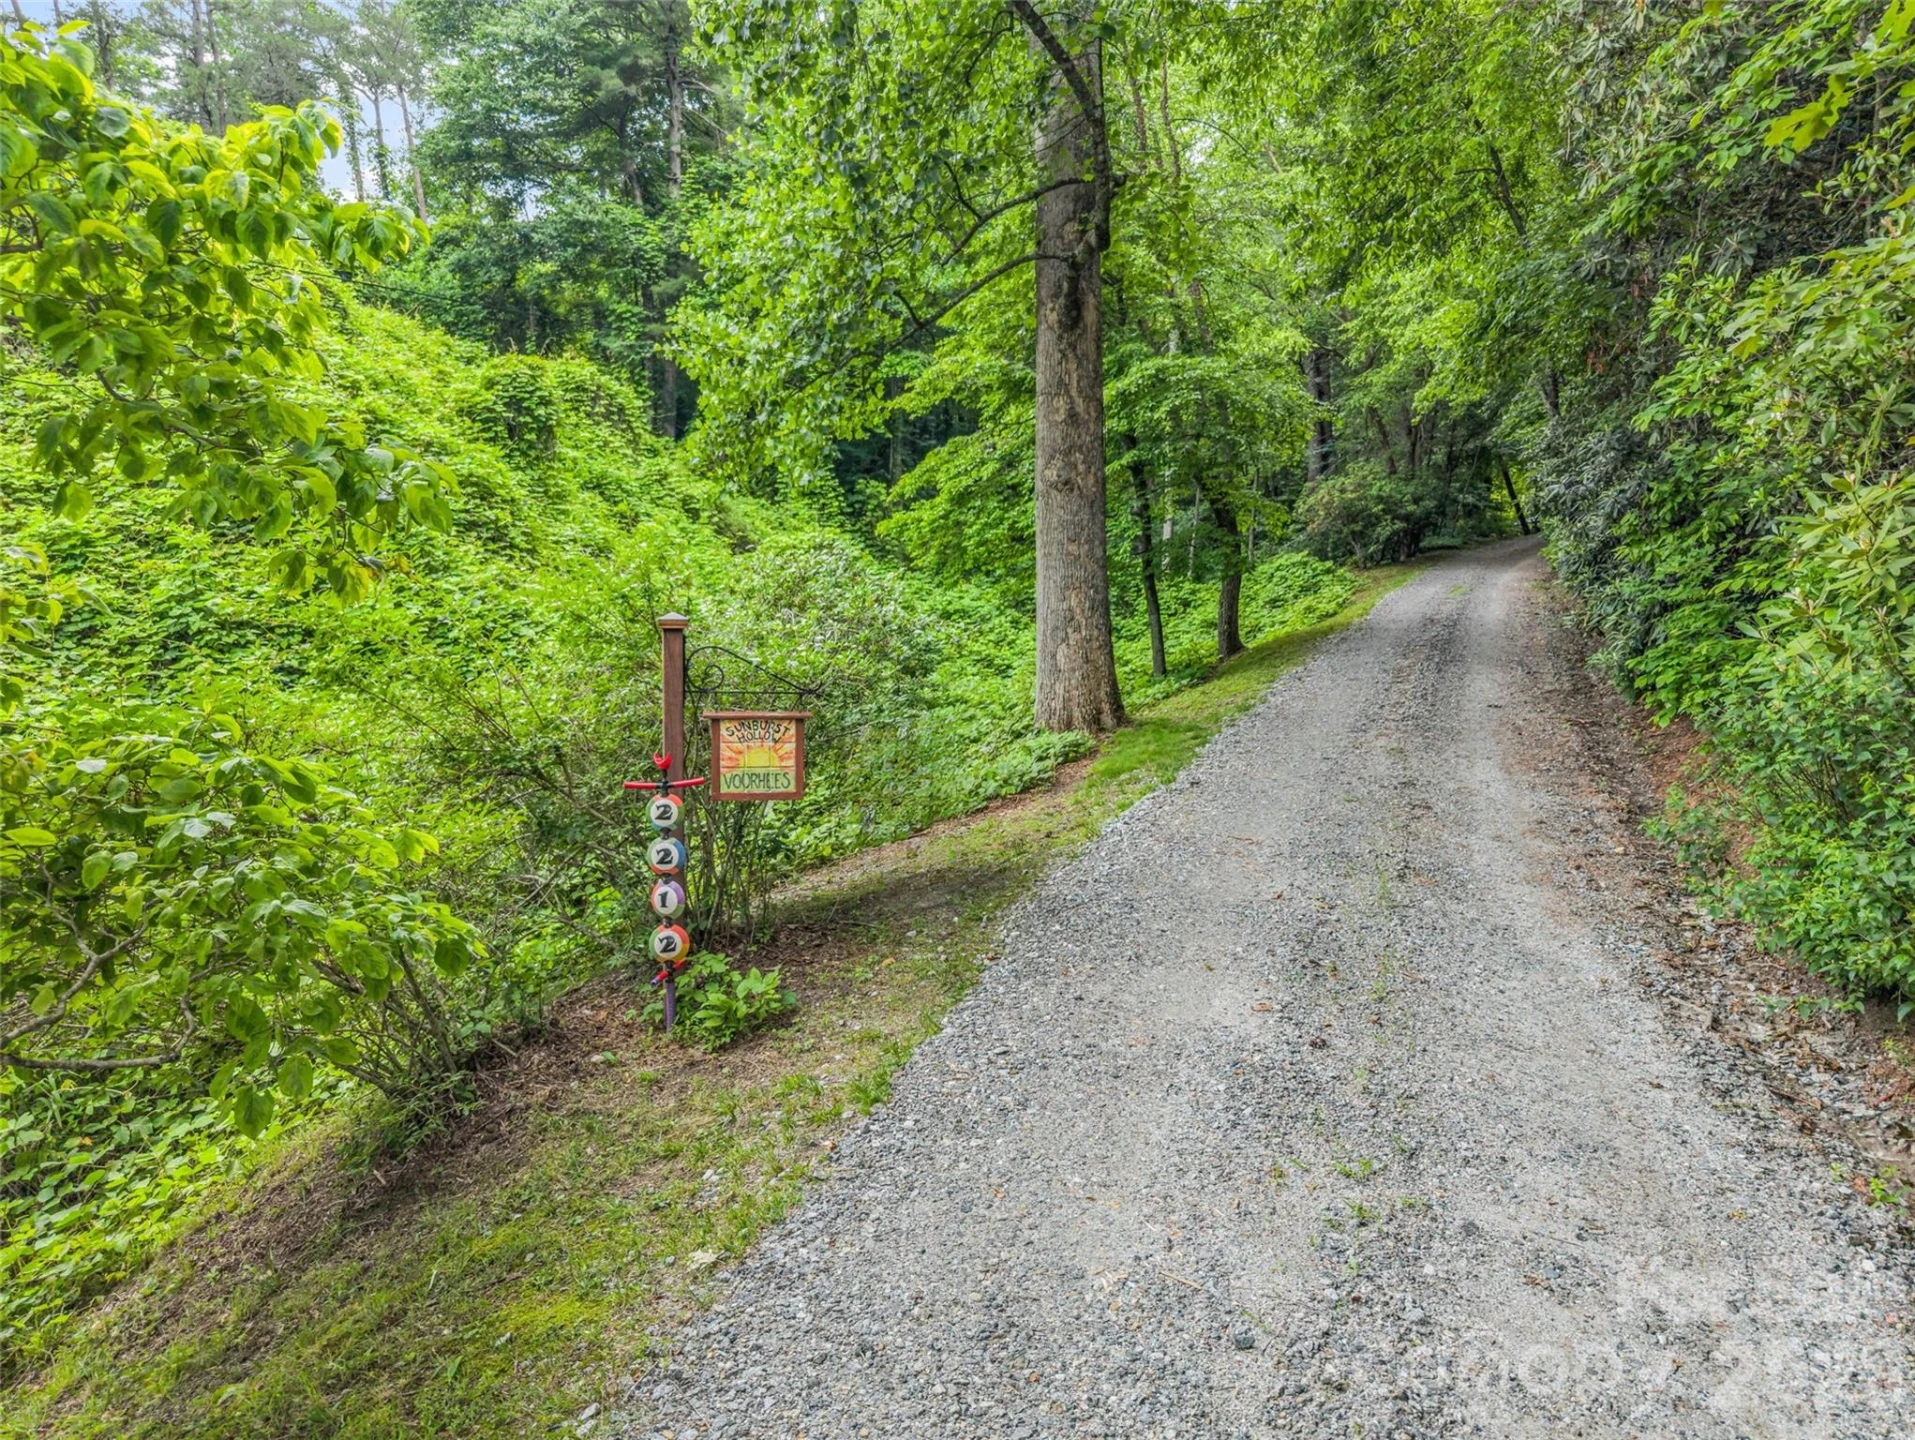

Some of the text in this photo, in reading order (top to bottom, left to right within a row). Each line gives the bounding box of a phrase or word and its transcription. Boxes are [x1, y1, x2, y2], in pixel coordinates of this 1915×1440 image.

[725, 720, 790, 737] SUNBURST
[736, 730, 782, 745] HOLLOW
[722, 772, 791, 790] VOORHEES
